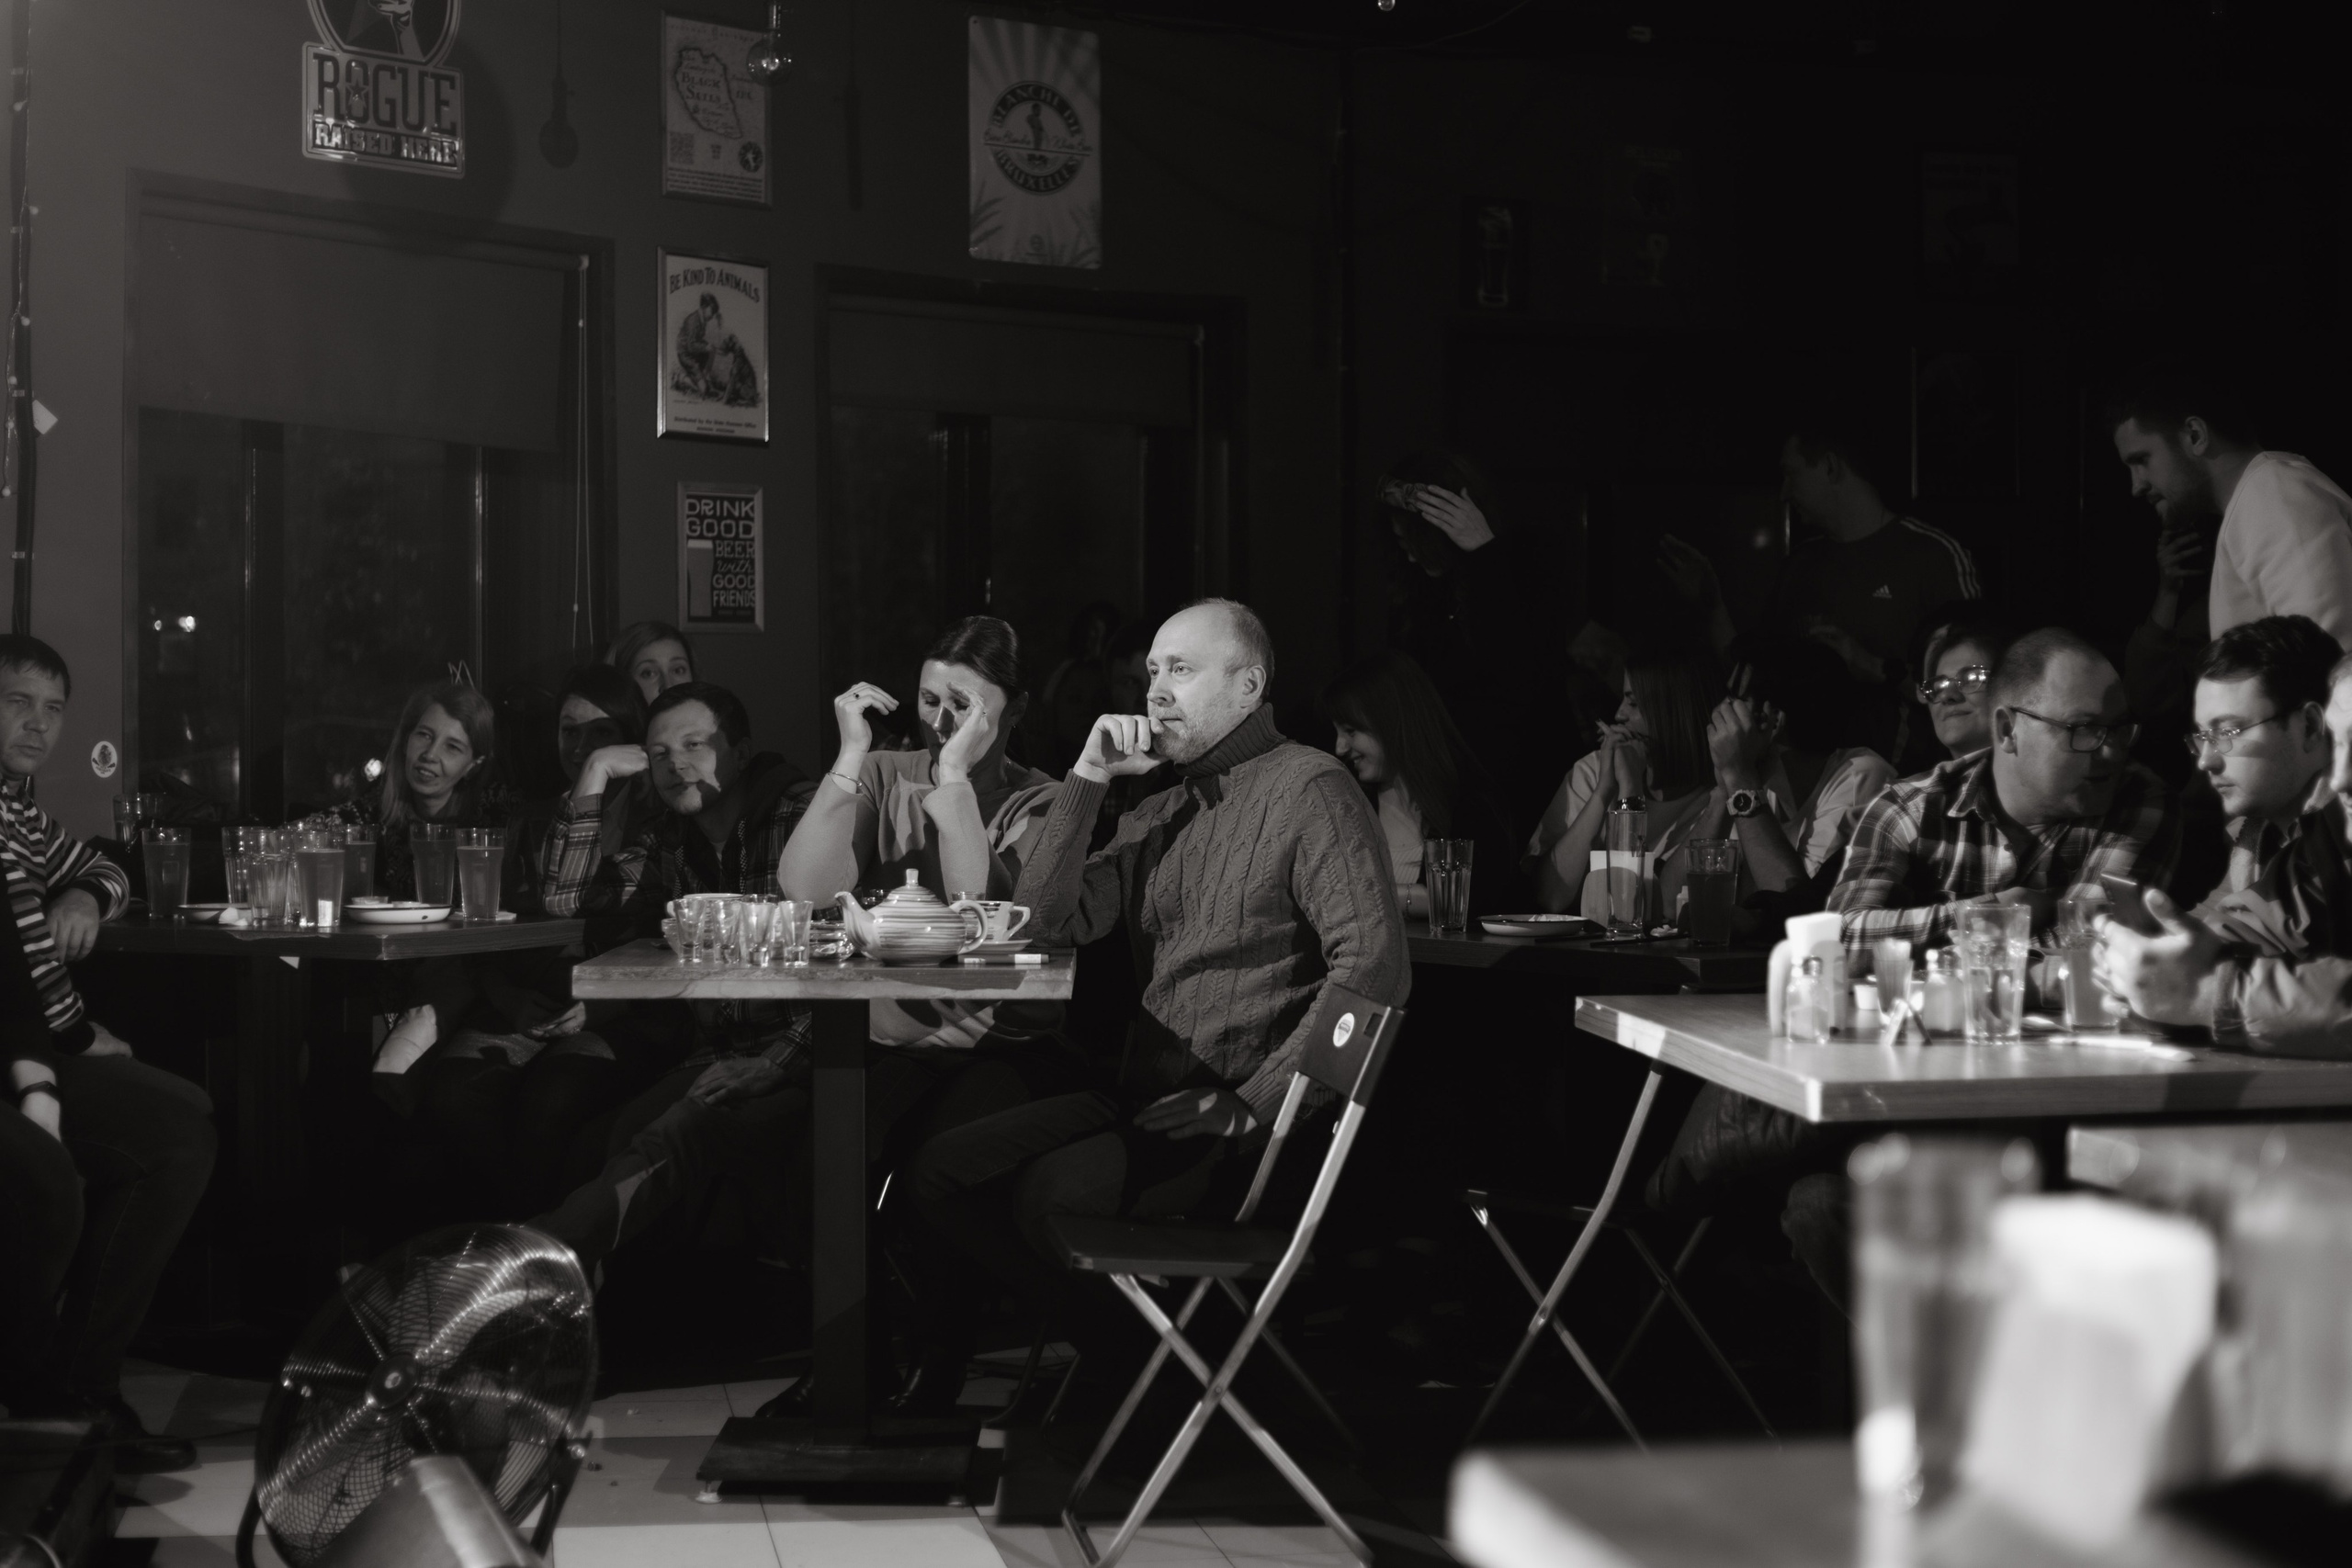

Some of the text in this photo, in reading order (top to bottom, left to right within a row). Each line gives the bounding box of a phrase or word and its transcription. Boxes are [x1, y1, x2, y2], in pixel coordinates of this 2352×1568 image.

[313, 52, 458, 137] ROGUE
[992, 85, 1060, 128] BLANCHE
[314, 122, 458, 164] RAISED HERE
[670, 266, 761, 303] BE KIND TO ANIMALS
[686, 498, 755, 518] DRINK
[686, 517, 755, 538] GOOD
[715, 540, 755, 558] BEER
[717, 558, 754, 574] with
[712, 574, 755, 590] GOOD
[712, 590, 755, 608] FRIENDS
